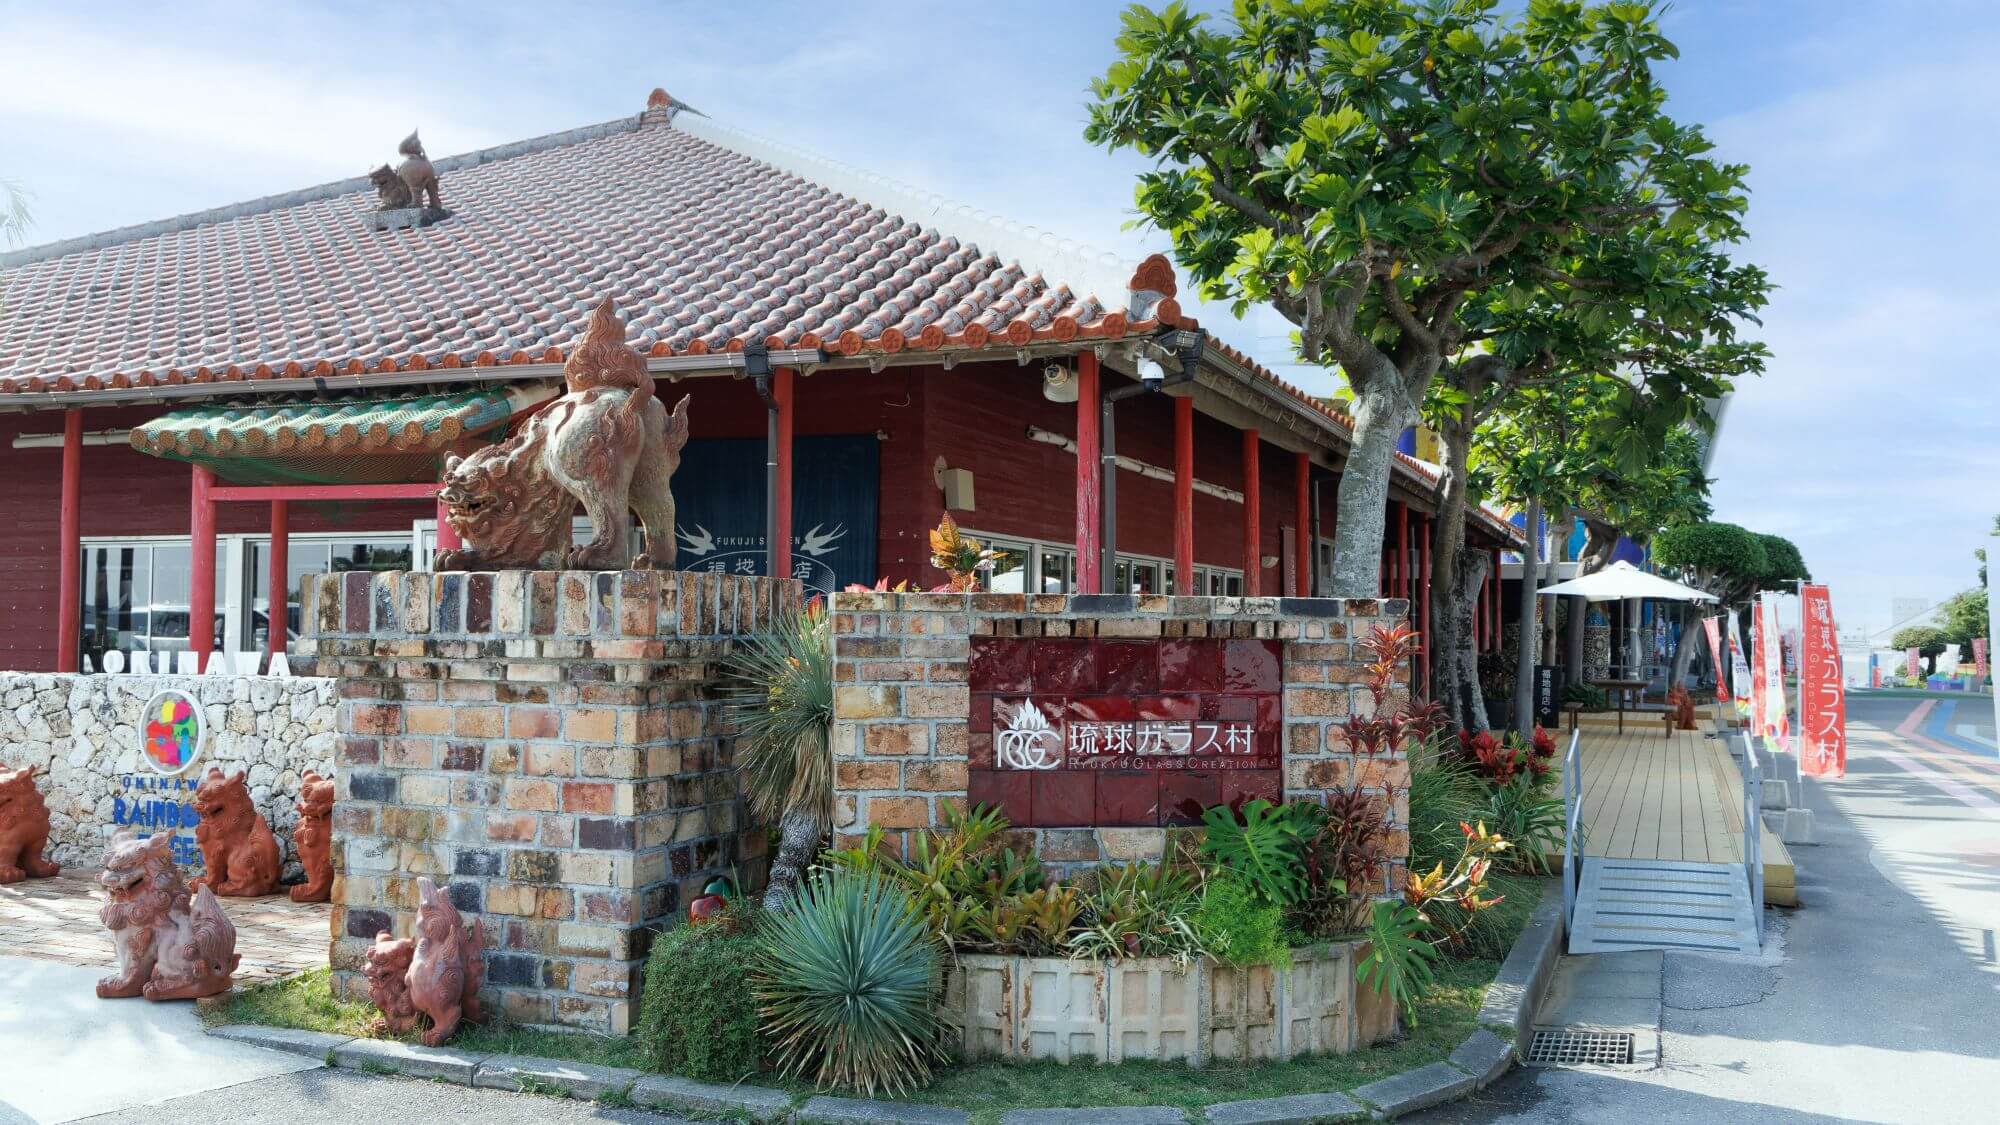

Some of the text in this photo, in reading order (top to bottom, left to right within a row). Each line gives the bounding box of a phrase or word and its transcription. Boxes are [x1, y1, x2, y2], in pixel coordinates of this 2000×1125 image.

[716, 537, 801, 545] FUKUJI SEN
[707, 558, 813, 579] 福地店
[102, 650, 291, 676] OKINAWA
[1069, 724, 1255, 754] 琉球ガラス村
[123, 776, 199, 791] OKINAW
[113, 797, 200, 830] RAINBO
